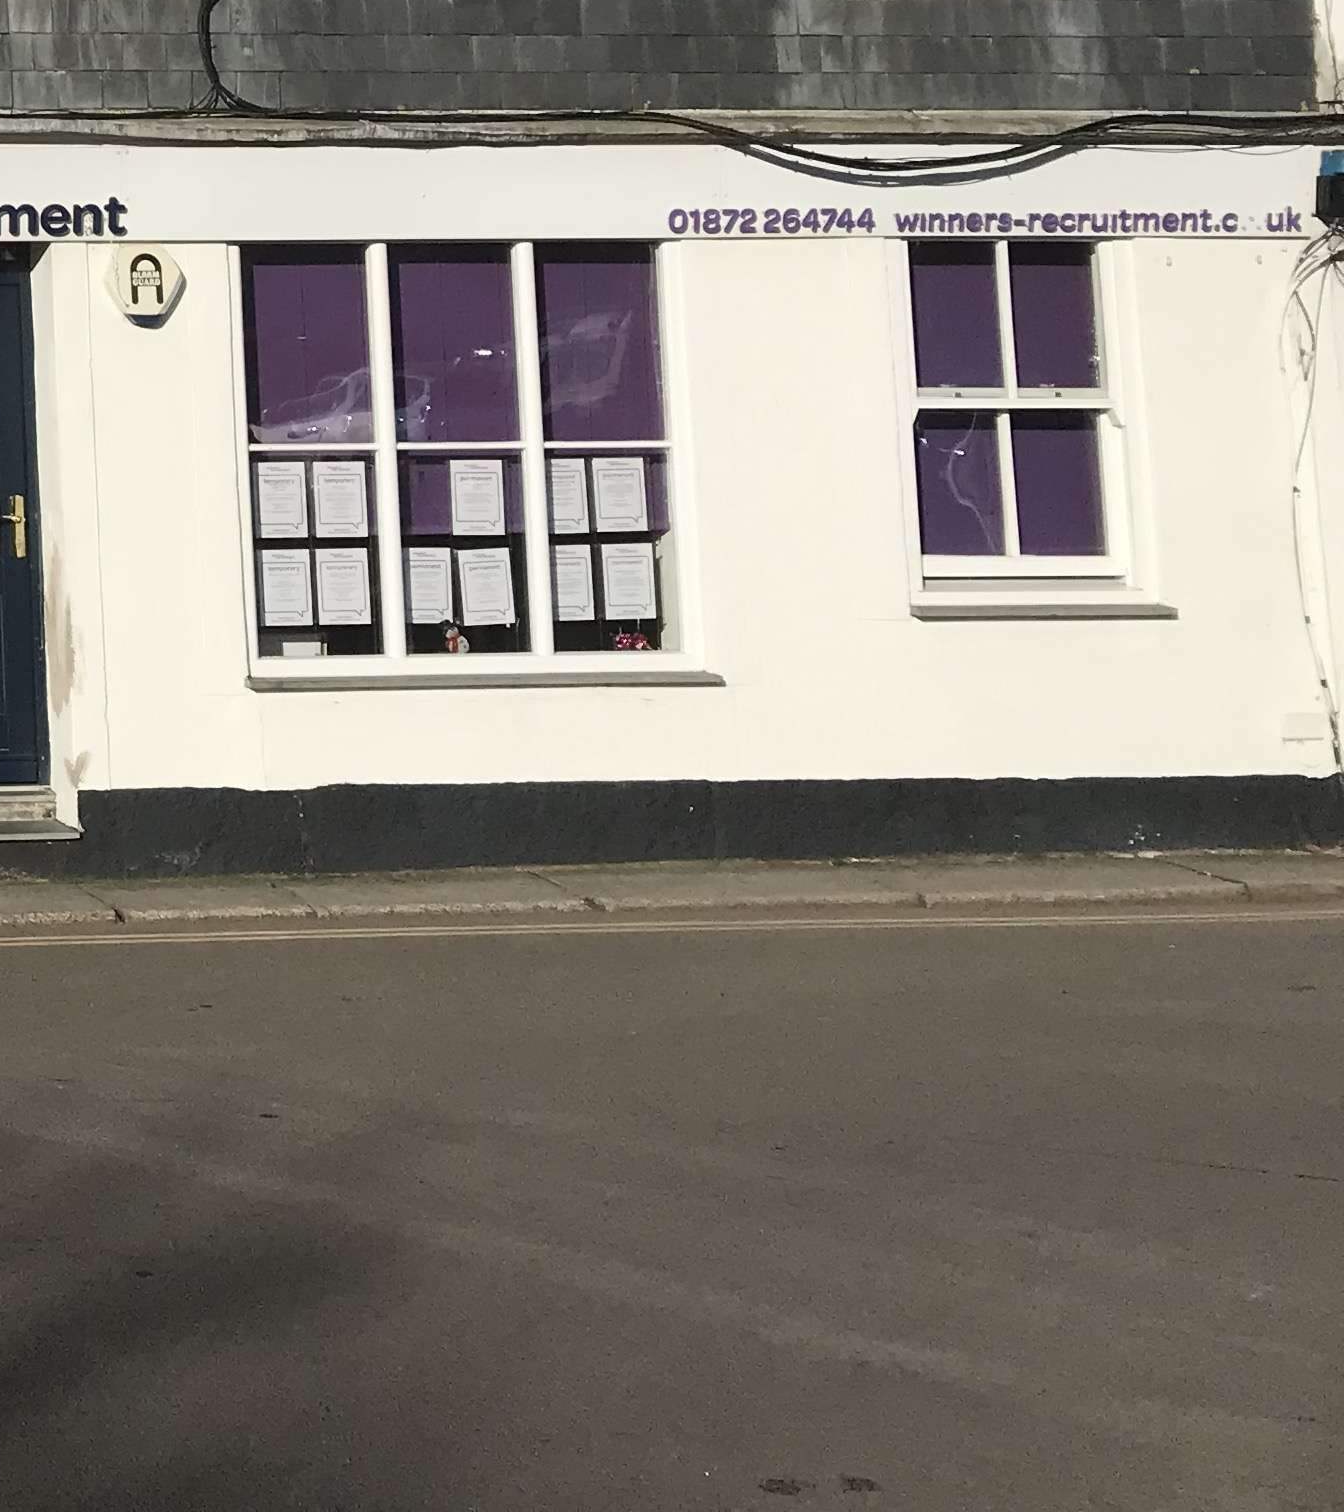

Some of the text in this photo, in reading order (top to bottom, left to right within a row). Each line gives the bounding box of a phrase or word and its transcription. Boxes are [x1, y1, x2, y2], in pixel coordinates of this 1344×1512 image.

[668, 208, 757, 234] 01872
[762, 208, 876, 234] 264744
[132, 278, 160, 286] GUARD
